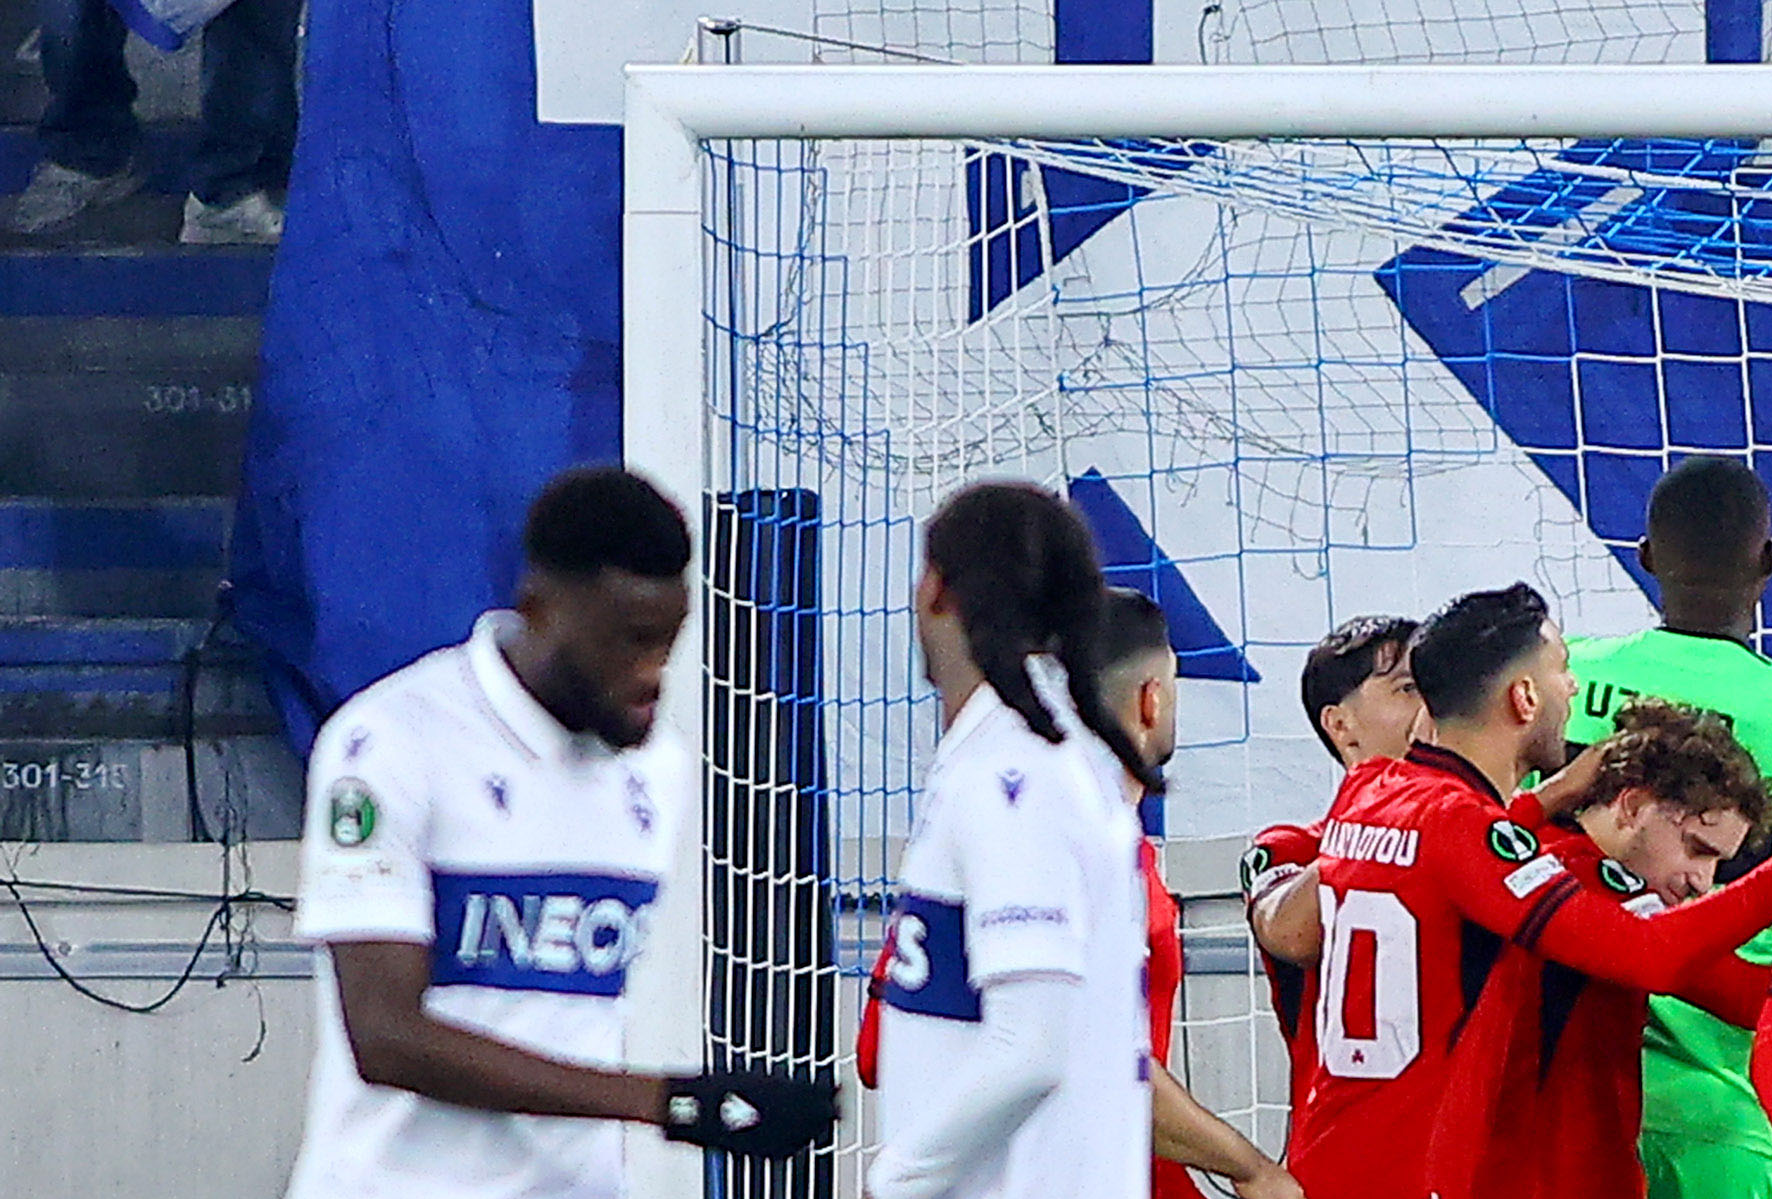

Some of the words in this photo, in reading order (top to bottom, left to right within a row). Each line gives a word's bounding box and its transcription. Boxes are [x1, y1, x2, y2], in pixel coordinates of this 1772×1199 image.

[142, 386, 252, 412] 301-31
[456, 892, 654, 977] INEO
[1316, 883, 1420, 1079] 0
